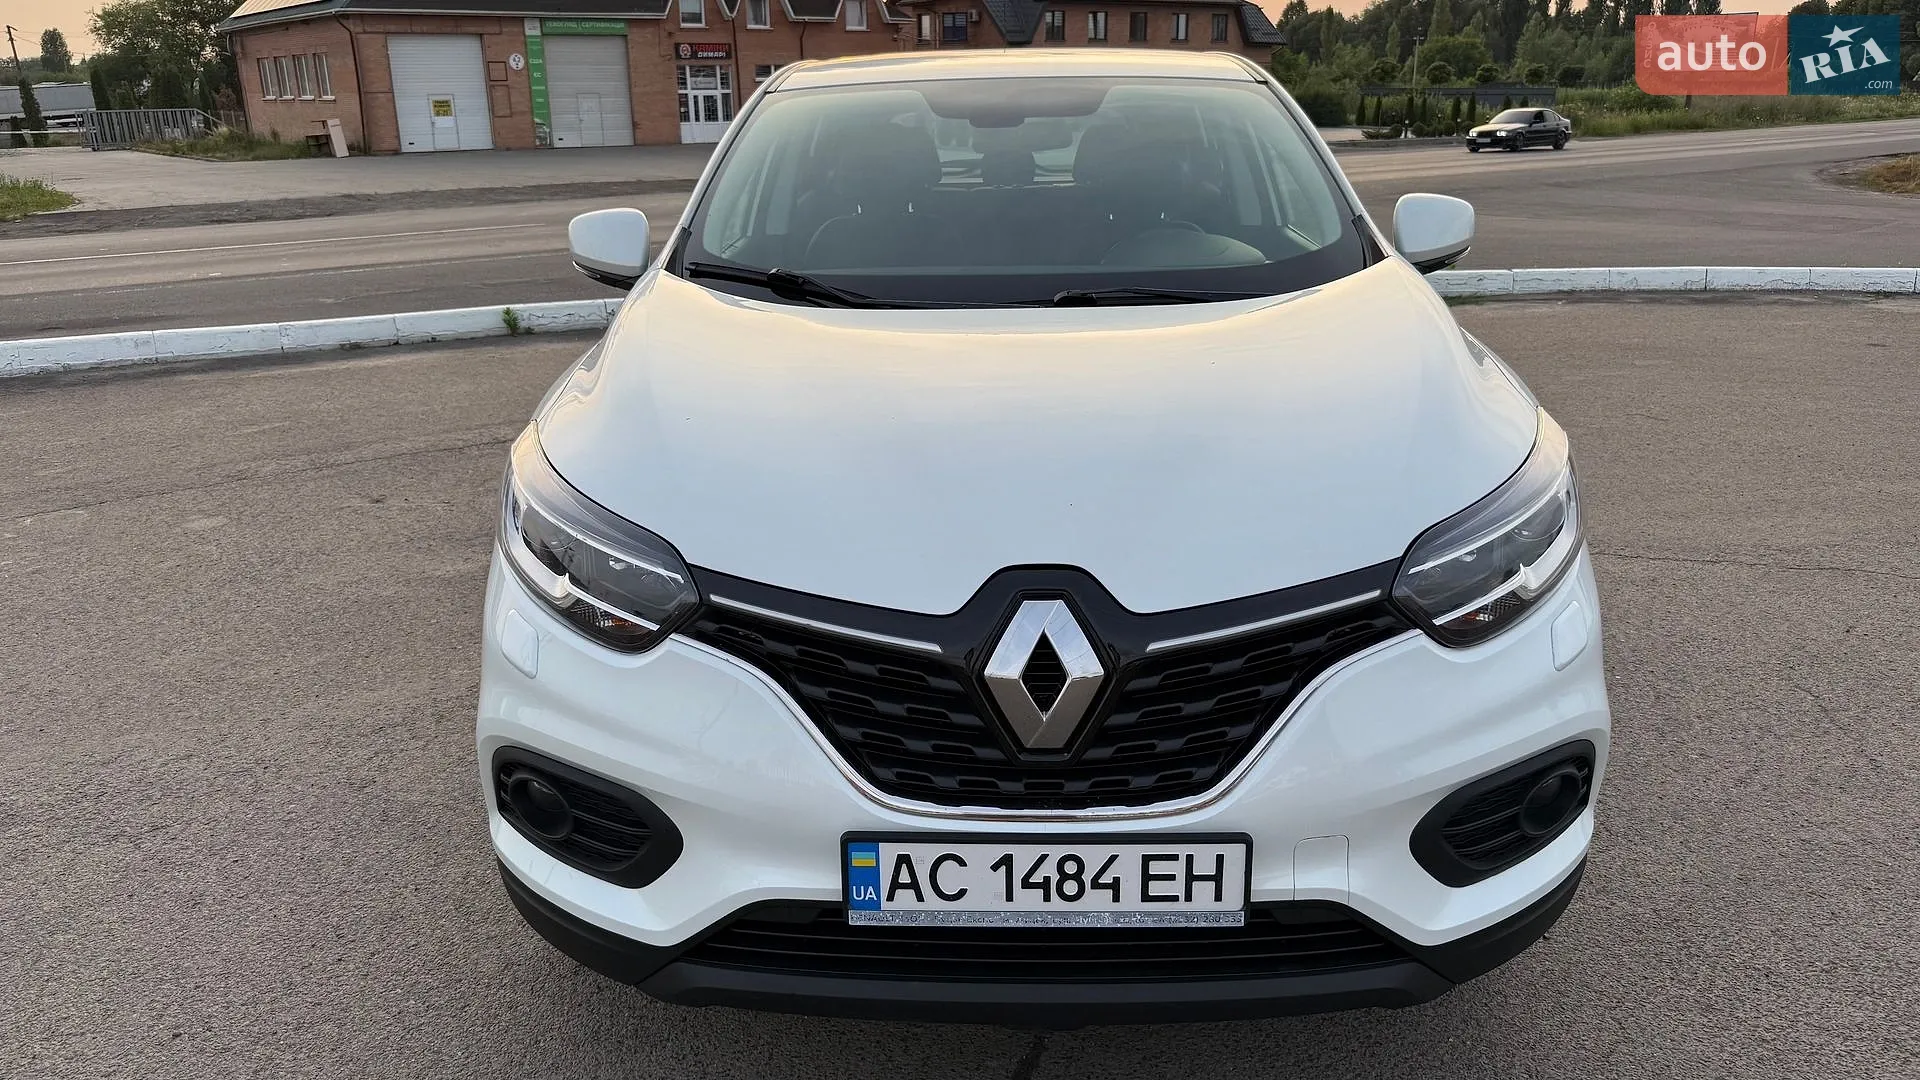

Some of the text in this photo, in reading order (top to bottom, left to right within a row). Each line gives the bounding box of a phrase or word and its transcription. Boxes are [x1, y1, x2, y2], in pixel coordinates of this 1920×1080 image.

[852, 885, 877, 901] UA
[885, 852, 1225, 903] AC 1484 EH
